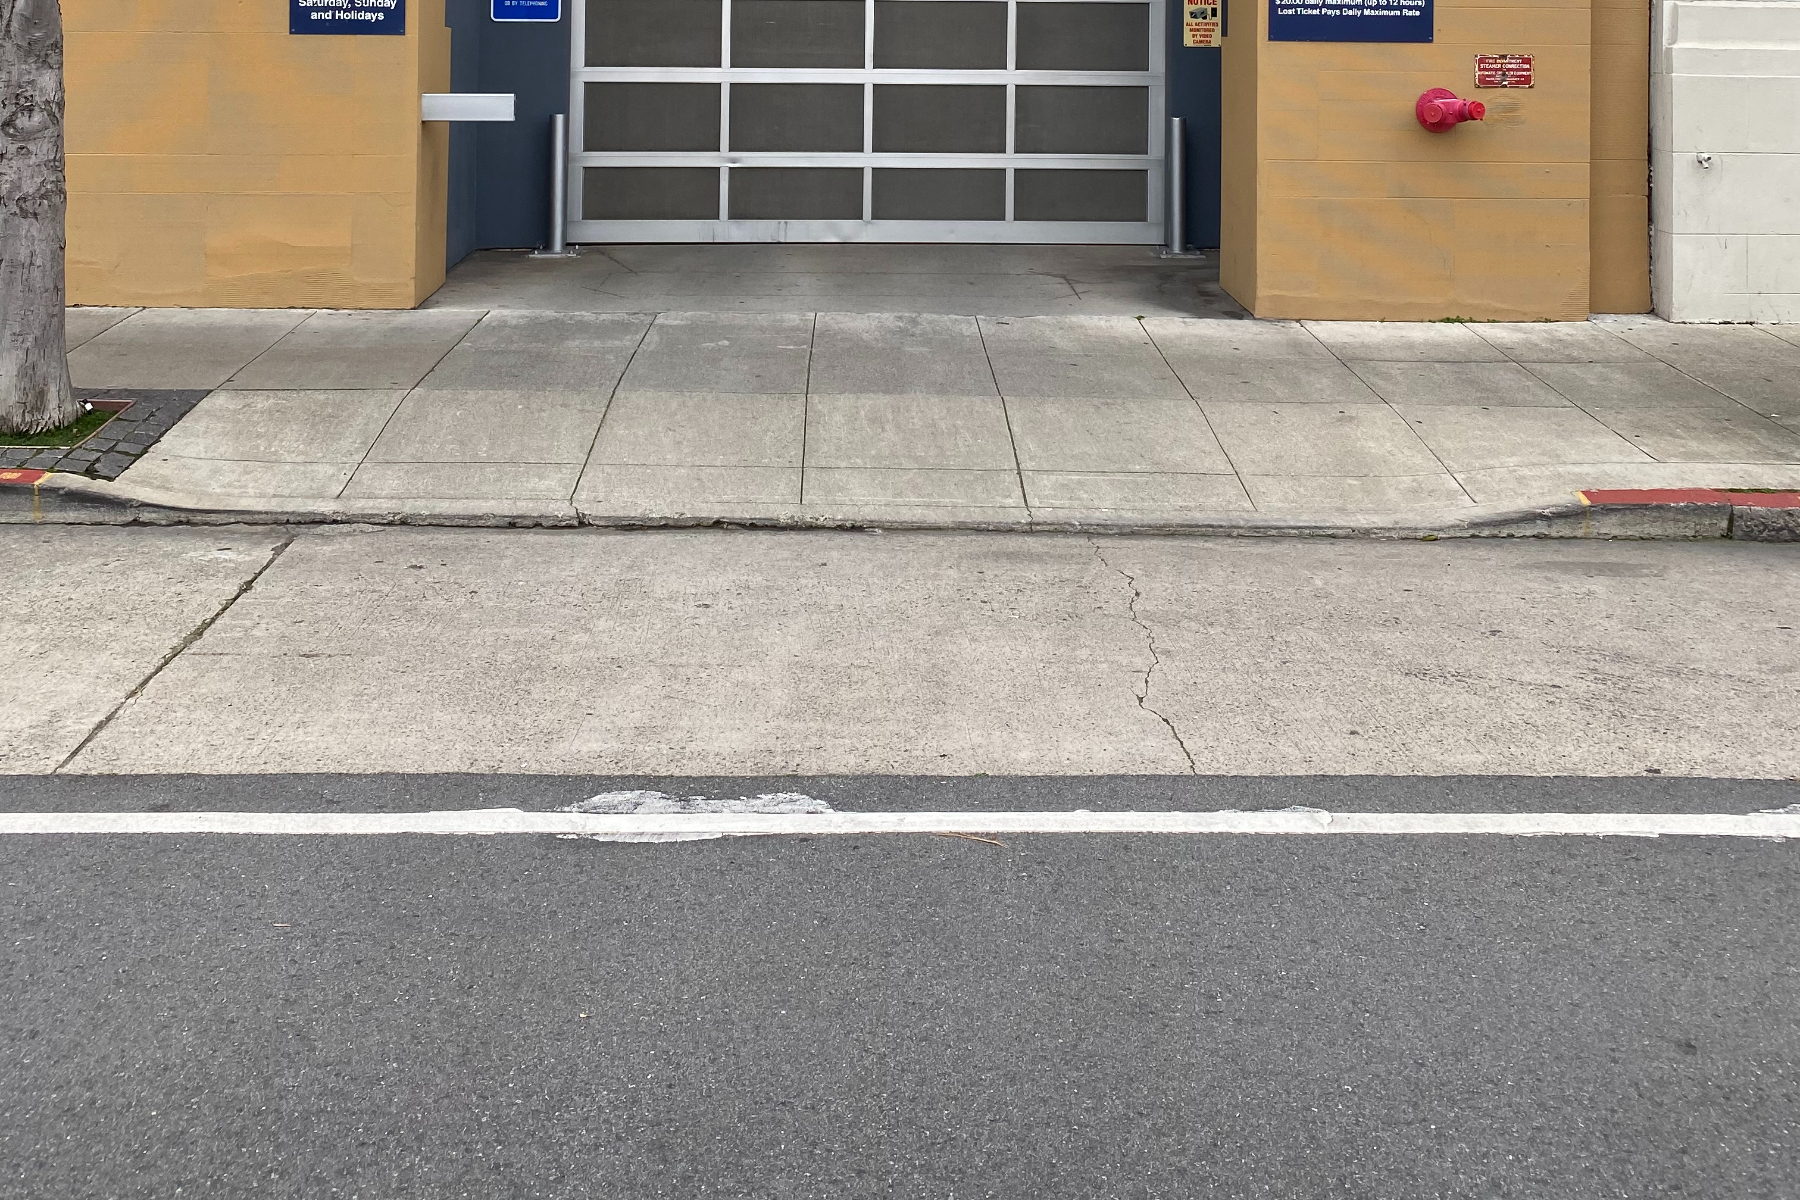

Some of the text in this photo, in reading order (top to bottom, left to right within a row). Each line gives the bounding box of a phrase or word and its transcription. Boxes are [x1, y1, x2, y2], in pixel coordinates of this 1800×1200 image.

[311, 10, 384, 22] and Holidays
[1322, 8, 1340, 16] Pays
[1343, 8, 1362, 17] Daily
